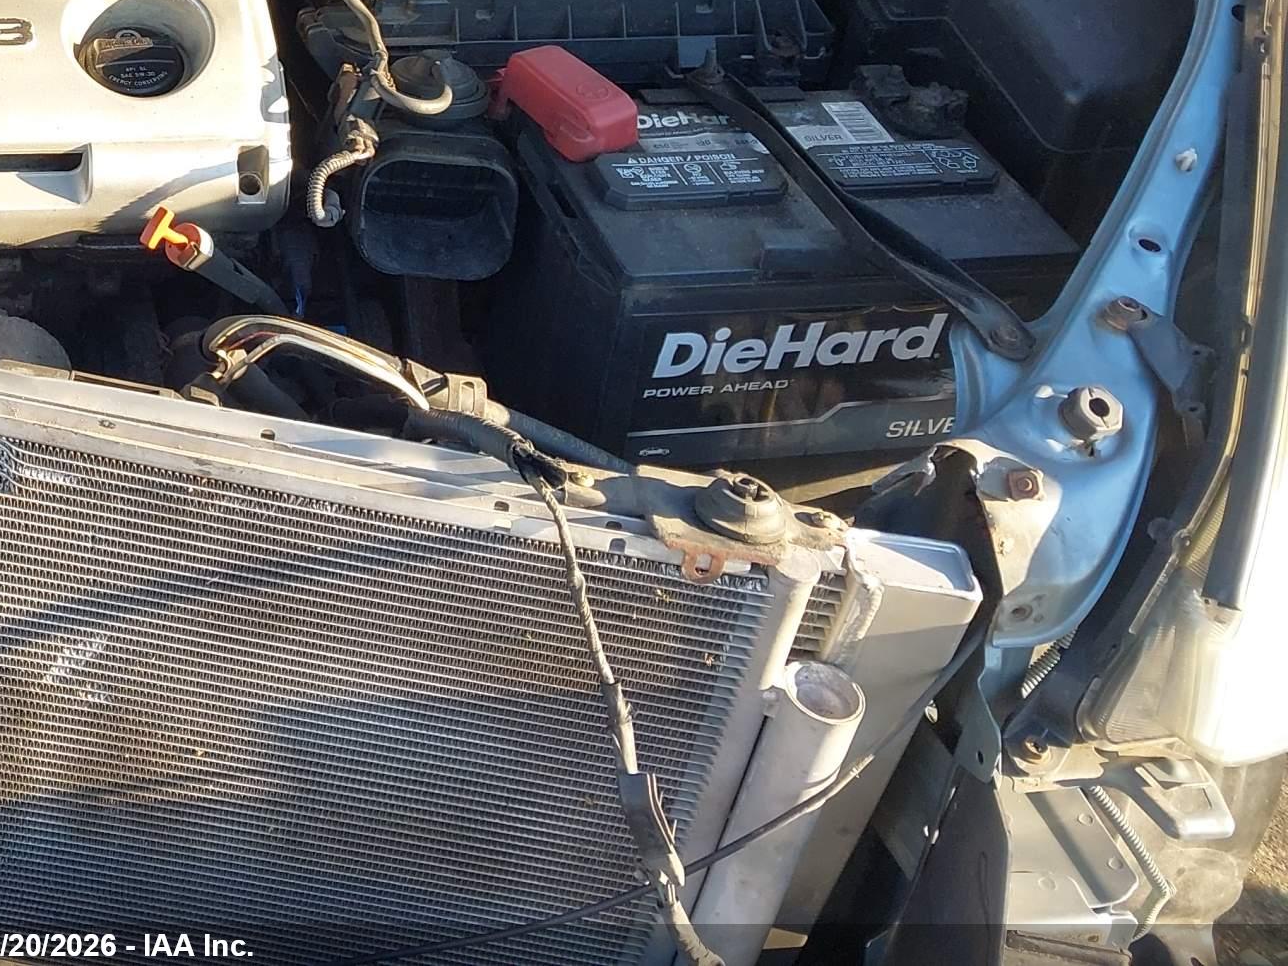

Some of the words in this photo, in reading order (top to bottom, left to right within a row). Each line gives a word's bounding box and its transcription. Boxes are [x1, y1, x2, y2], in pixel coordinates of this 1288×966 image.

[636, 110, 731, 130] DieHar
[804, 134, 843, 142] SILVER
[638, 155, 684, 165] DANGER
[694, 153, 737, 162] POISON
[652, 313, 949, 379] DieHard
[643, 385, 714, 399] POWER
[720, 379, 790, 394] AHEAD
[886, 416, 956, 438] SILVE
